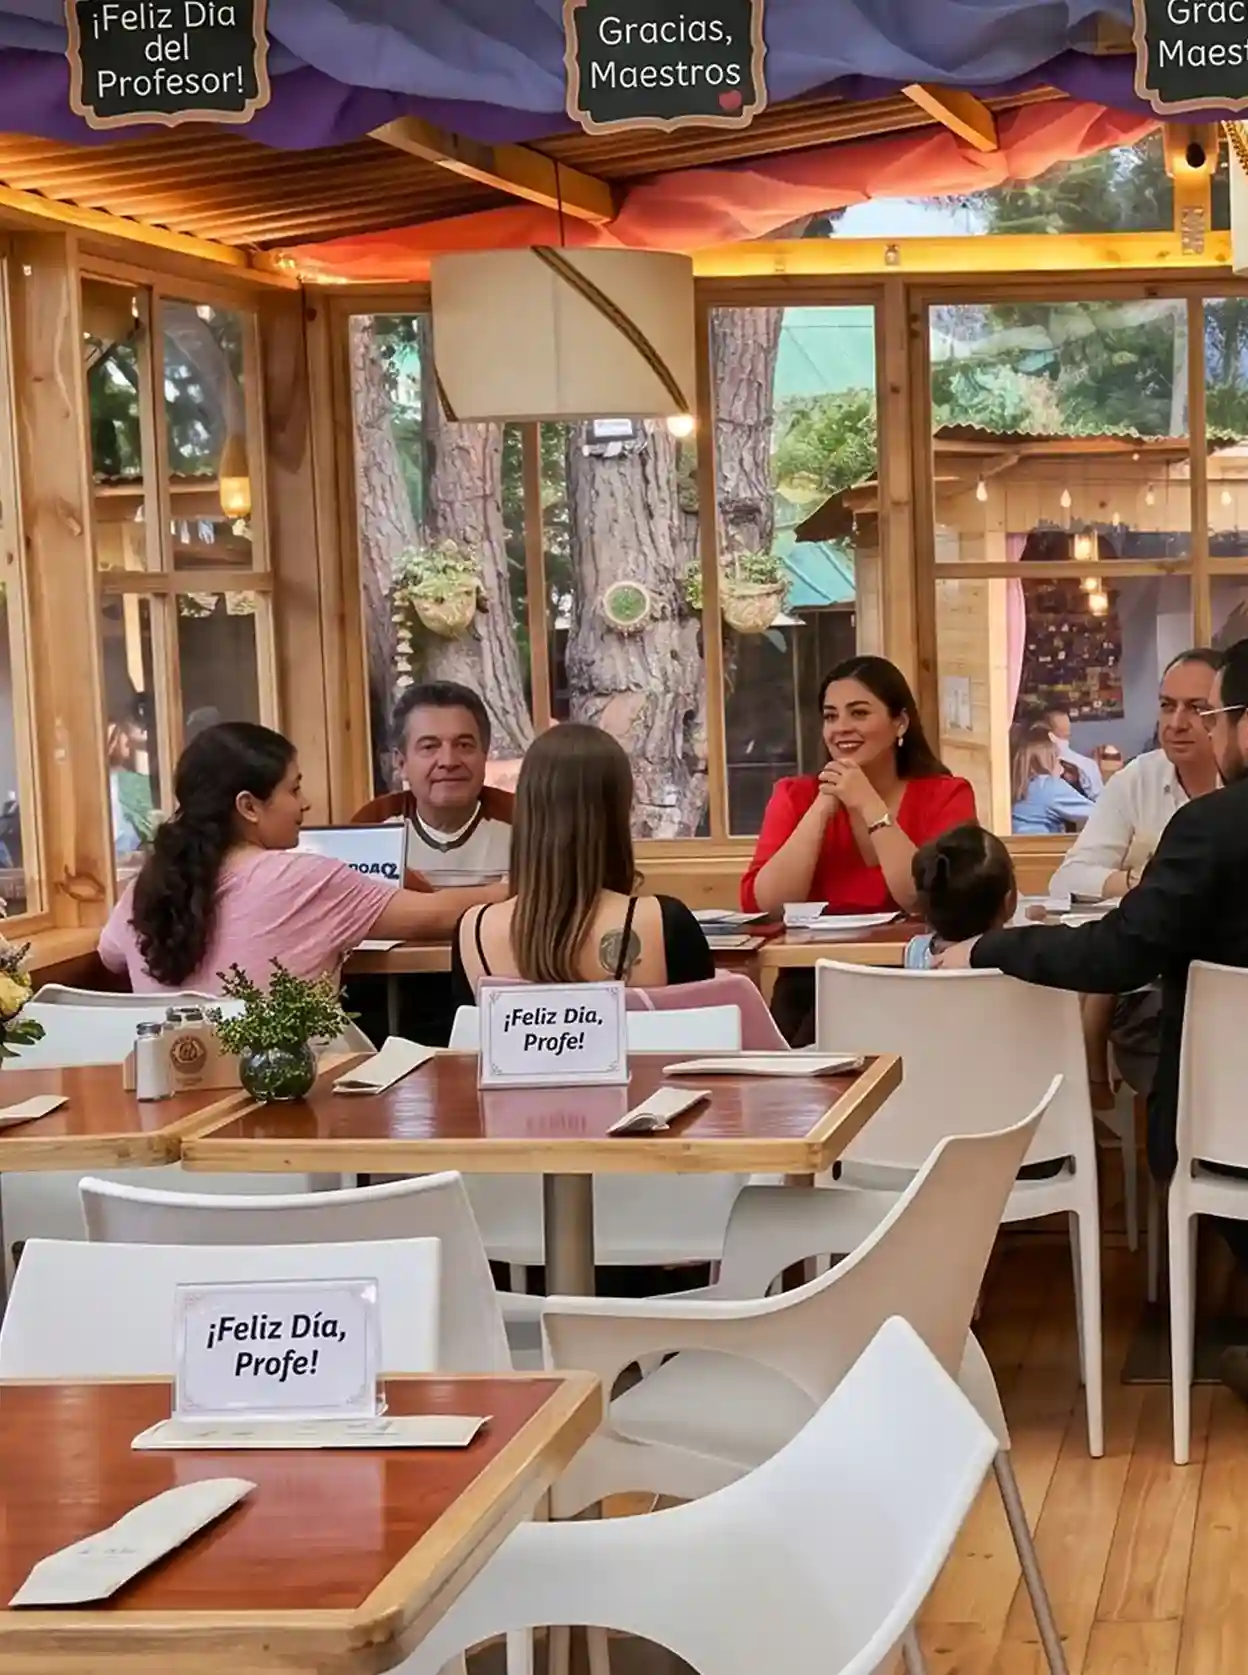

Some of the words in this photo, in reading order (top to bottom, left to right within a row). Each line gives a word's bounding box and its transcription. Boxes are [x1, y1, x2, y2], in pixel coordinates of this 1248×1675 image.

[92, 2, 173, 39] ¡Feliz
[599, 14, 733, 46] Gracias,
[145, 32, 189, 61] del
[97, 66, 243, 98] Profesor!
[590, 61, 741, 89] Maestros
[504, 1008, 557, 1032] ¡Feliz
[524, 1032, 585, 1056] Profe!
[207, 1314, 283, 1349] ¡Feliz
[290, 1311, 347, 1342] Día,
[234, 1350, 319, 1382] Profe!
